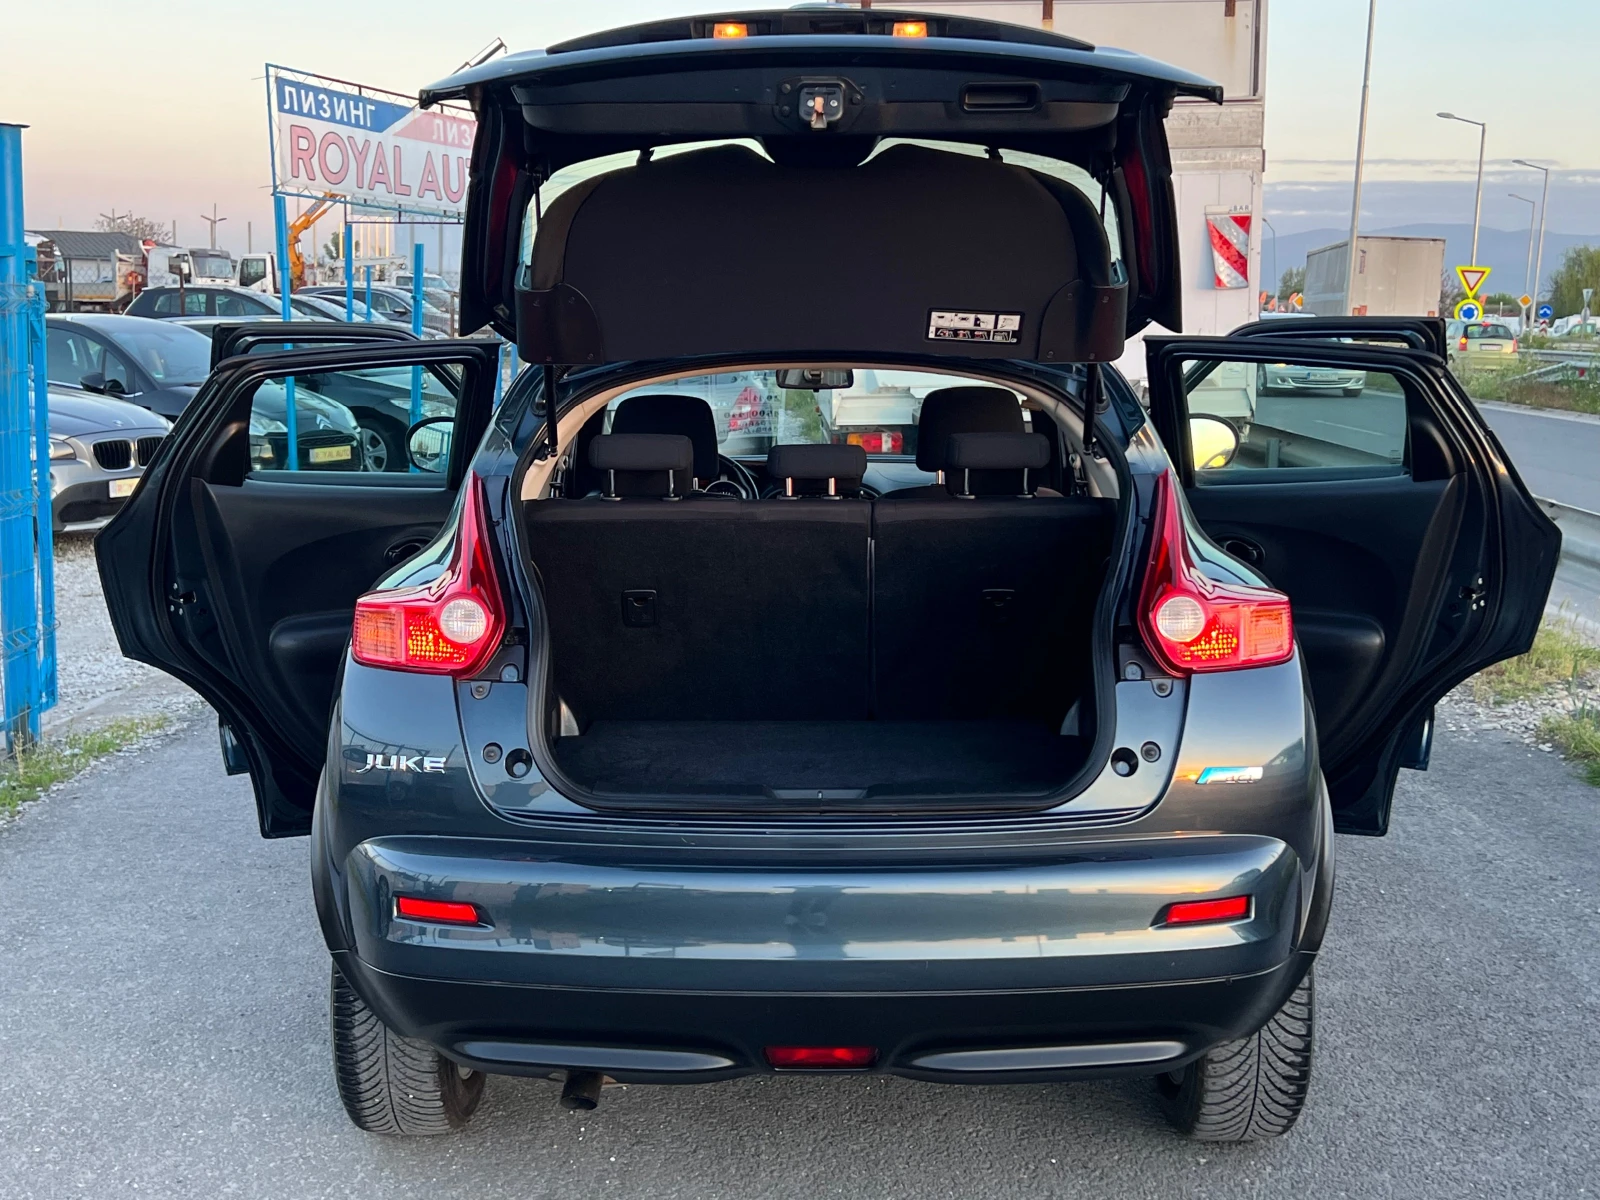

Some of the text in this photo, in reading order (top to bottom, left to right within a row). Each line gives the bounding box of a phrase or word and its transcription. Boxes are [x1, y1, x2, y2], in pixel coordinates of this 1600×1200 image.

[284, 85, 375, 127] ЛИЗИНГ
[290, 124, 411, 196] ROYAL
[356, 753, 447, 774] JUKE
